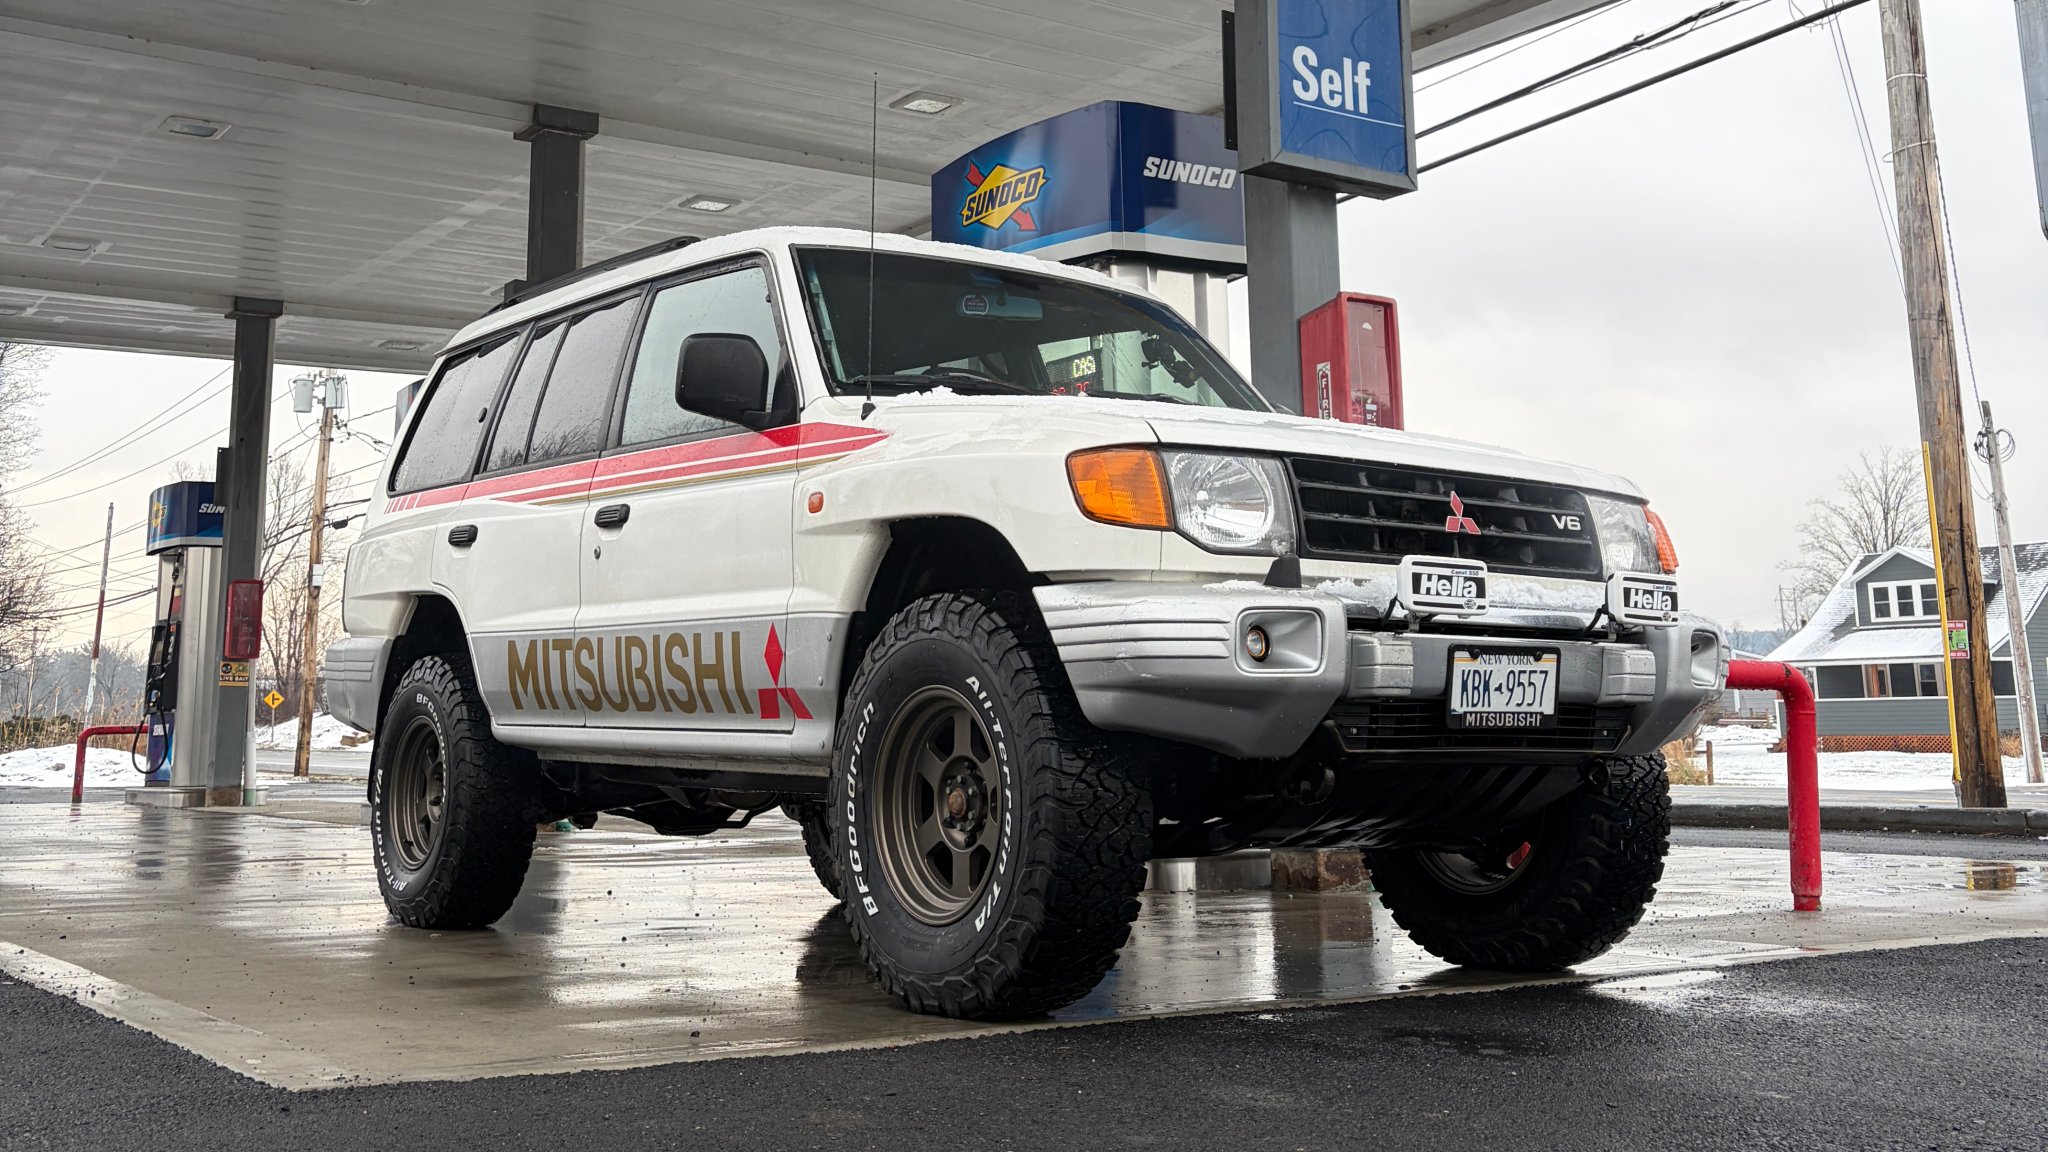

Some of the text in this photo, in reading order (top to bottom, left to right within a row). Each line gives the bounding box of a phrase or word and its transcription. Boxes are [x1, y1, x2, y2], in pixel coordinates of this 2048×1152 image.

[1292, 45, 1371, 114] Self
[1143, 156, 1237, 189] SUNOCO
[965, 172, 1041, 222] SUNOCO
[1321, 378, 1330, 419] FIRE
[1551, 513, 1581, 531] V6
[1419, 573, 1477, 598] Hella
[1629, 588, 1672, 611] Hella
[507, 631, 754, 714] MITSUBISHI
[1479, 654, 1533, 666] NEW YORK
[1460, 669, 1549, 708] KBK 9557
[1465, 713, 1541, 727] MITSUBISHI
[847, 701, 879, 916] BFGoodrich
[965, 675, 1012, 933] All-Terrain T/A
